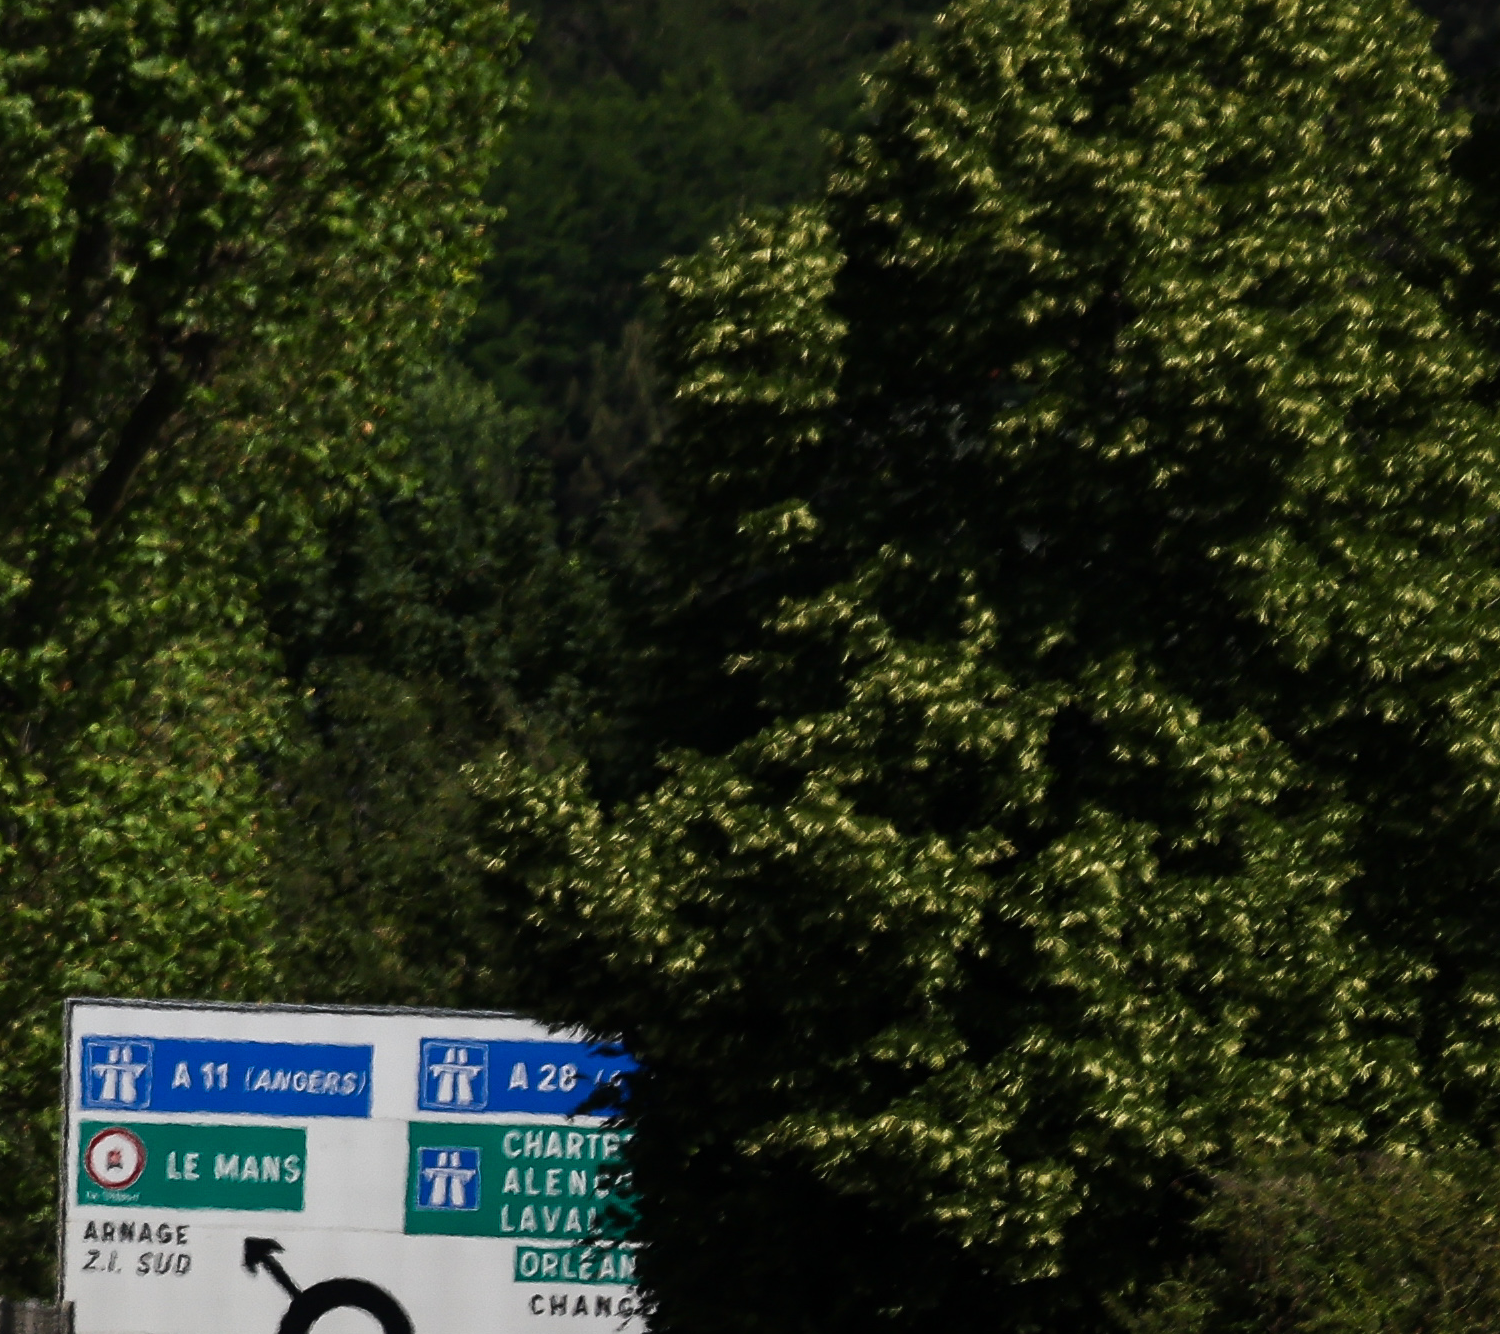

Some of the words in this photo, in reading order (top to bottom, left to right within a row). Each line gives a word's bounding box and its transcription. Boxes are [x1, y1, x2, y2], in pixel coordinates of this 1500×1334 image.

[171, 1061, 192, 1090] A
[200, 1061, 229, 1092] 11
[244, 1066, 368, 1097] (ANGERS)
[508, 1062, 530, 1091] A
[537, 1062, 579, 1093] 28
[502, 1129, 635, 1161] CHARTR
[165, 1150, 201, 1181] LE
[214, 1153, 301, 1185] MANS
[83, 1220, 190, 1246] ARNAGE
[136, 1251, 192, 1277] SUD
